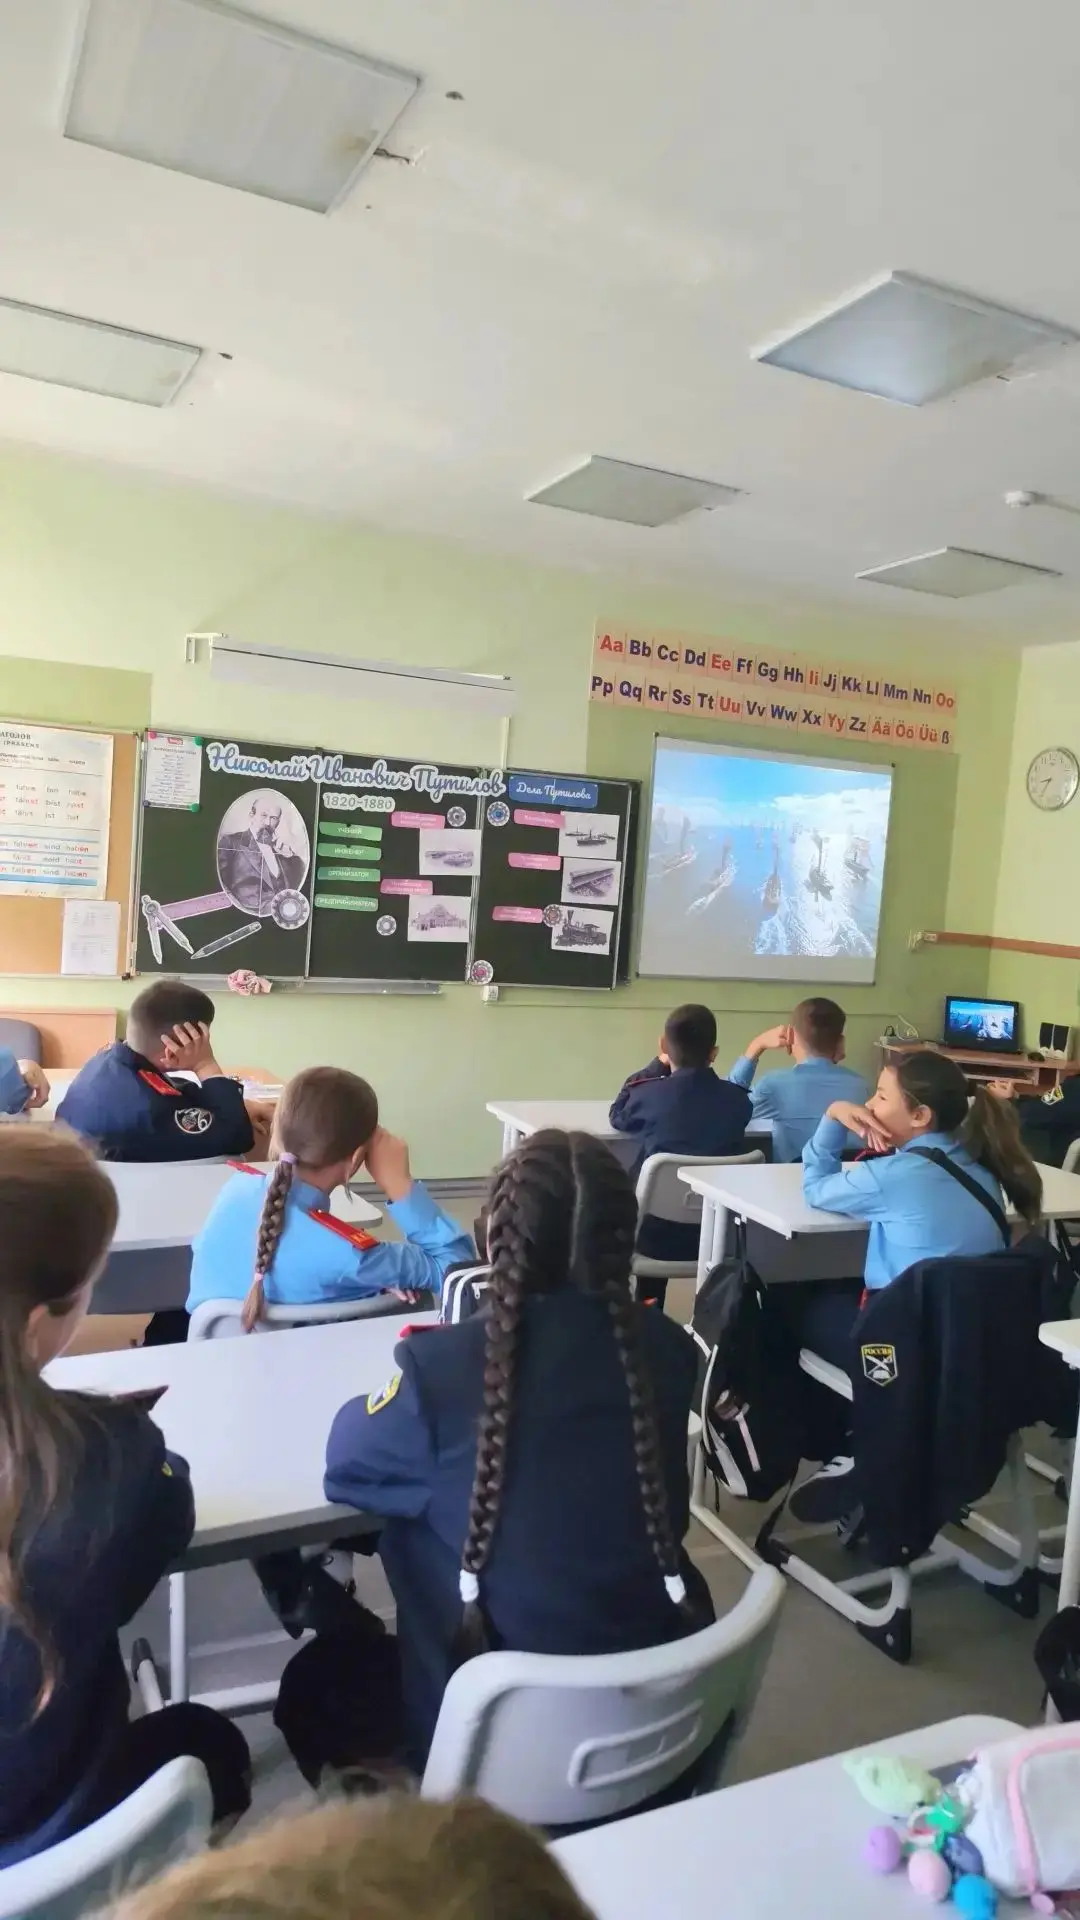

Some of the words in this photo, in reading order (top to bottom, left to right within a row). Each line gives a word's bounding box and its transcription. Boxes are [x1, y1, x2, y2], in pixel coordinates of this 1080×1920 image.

[600, 635, 623, 653] Aa
[629, 639, 651, 658] Bb
[657, 645, 679, 662] Cc
[684, 649, 706, 667] Dd
[711, 653, 731, 671] Ee
[737, 658, 753, 674] Ff
[758, 662, 778, 682] Gg
[784, 666, 803, 683] Hh
[809, 670, 819, 686] Ii
[823, 674, 837, 692] Jj
[841, 676, 861, 693] Kk
[866, 680, 879, 696] Ll
[884, 683, 908, 700] Mm
[913, 688, 932, 704] Nn
[936, 692, 954, 708] Oo
[591, 676, 613, 697] Pp
[619, 680, 642, 702] Qq
[648, 685, 667, 702] Rr
[672, 689, 692, 706] Ss
[698, 692, 714, 710] Tt
[719, 696, 740, 714] Uu
[746, 700, 766, 717] Vv
[771, 704, 797, 722] Ww
[802, 709, 822, 726] Xx
[828, 713, 846, 732] Yy
[849, 716, 867, 732] Zz
[872, 716, 891, 736] Ää
[895, 720, 914, 739] Öö
[919, 723, 938, 743] Üü
[208, 744, 308, 778] Николай
[310, 757, 410, 788] Иванович
[412, 768, 504, 801] Путилов
[516, 781, 543, 795] Дела
[543, 783, 592, 801] Путилова
[324, 794, 393, 811] 1820-1880
